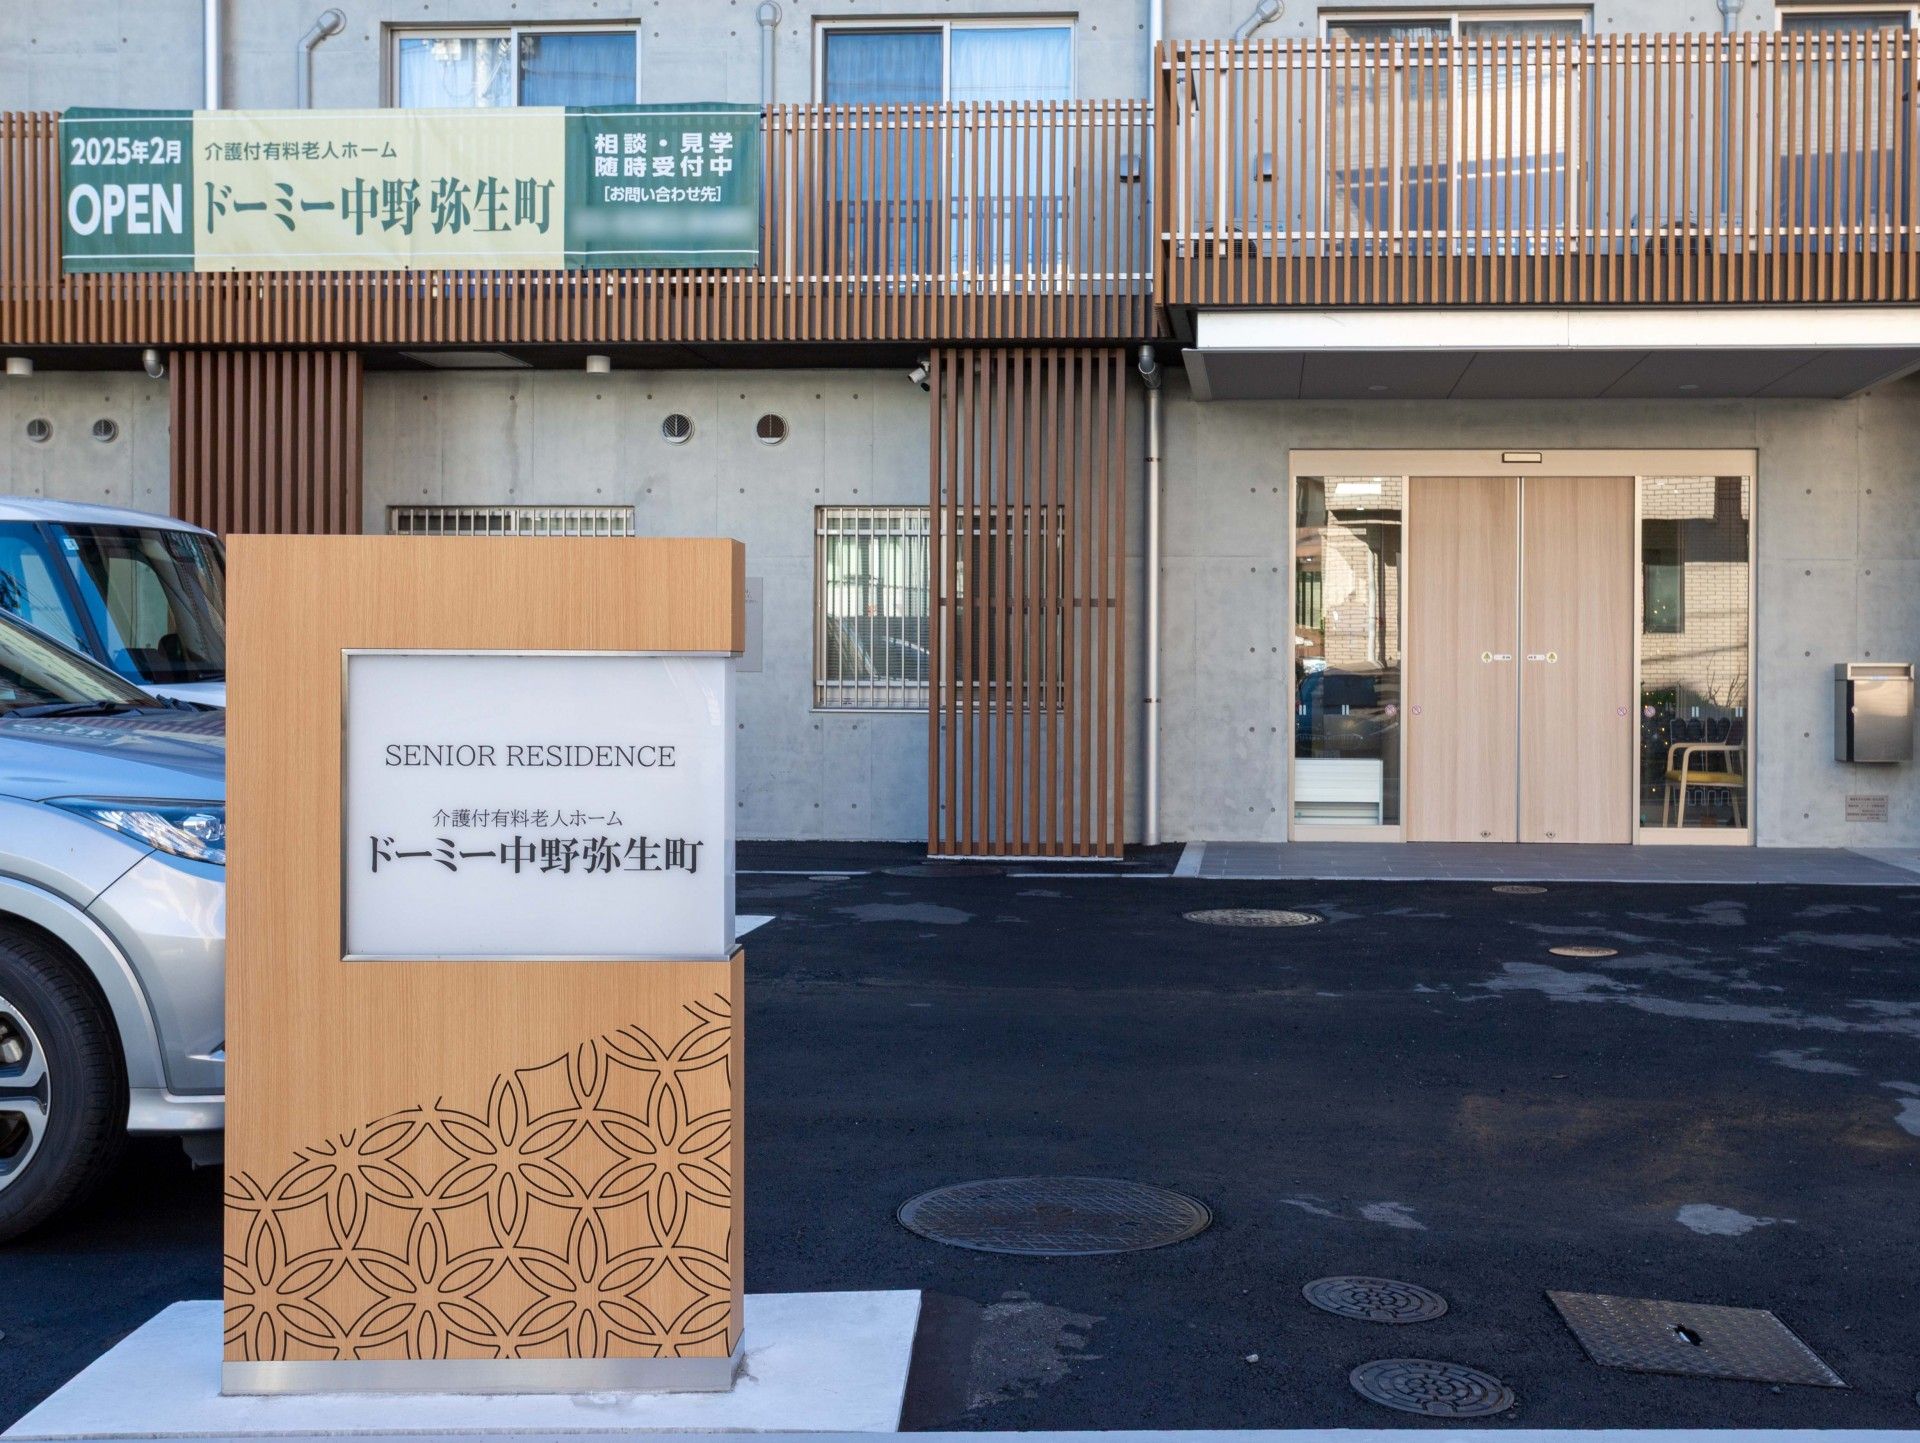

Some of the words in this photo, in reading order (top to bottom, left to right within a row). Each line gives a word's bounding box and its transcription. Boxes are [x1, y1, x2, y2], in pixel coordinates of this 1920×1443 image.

[70, 136, 182, 166] 2025年2月
[204, 141, 398, 161] 介護付有料老人ホーム
[594, 132, 733, 154] 相談・見学
[594, 156, 733, 178] 随時受付中
[67, 183, 183, 236] OPEN
[204, 175, 556, 236] ドーミー中野弥生町
[385, 744, 496, 767] SENIOR
[506, 745, 676, 767] RESIDENCE
[432, 808, 624, 828] 介護付有料老人ホーム
[369, 835, 704, 874] ドーミー中野弥生町
